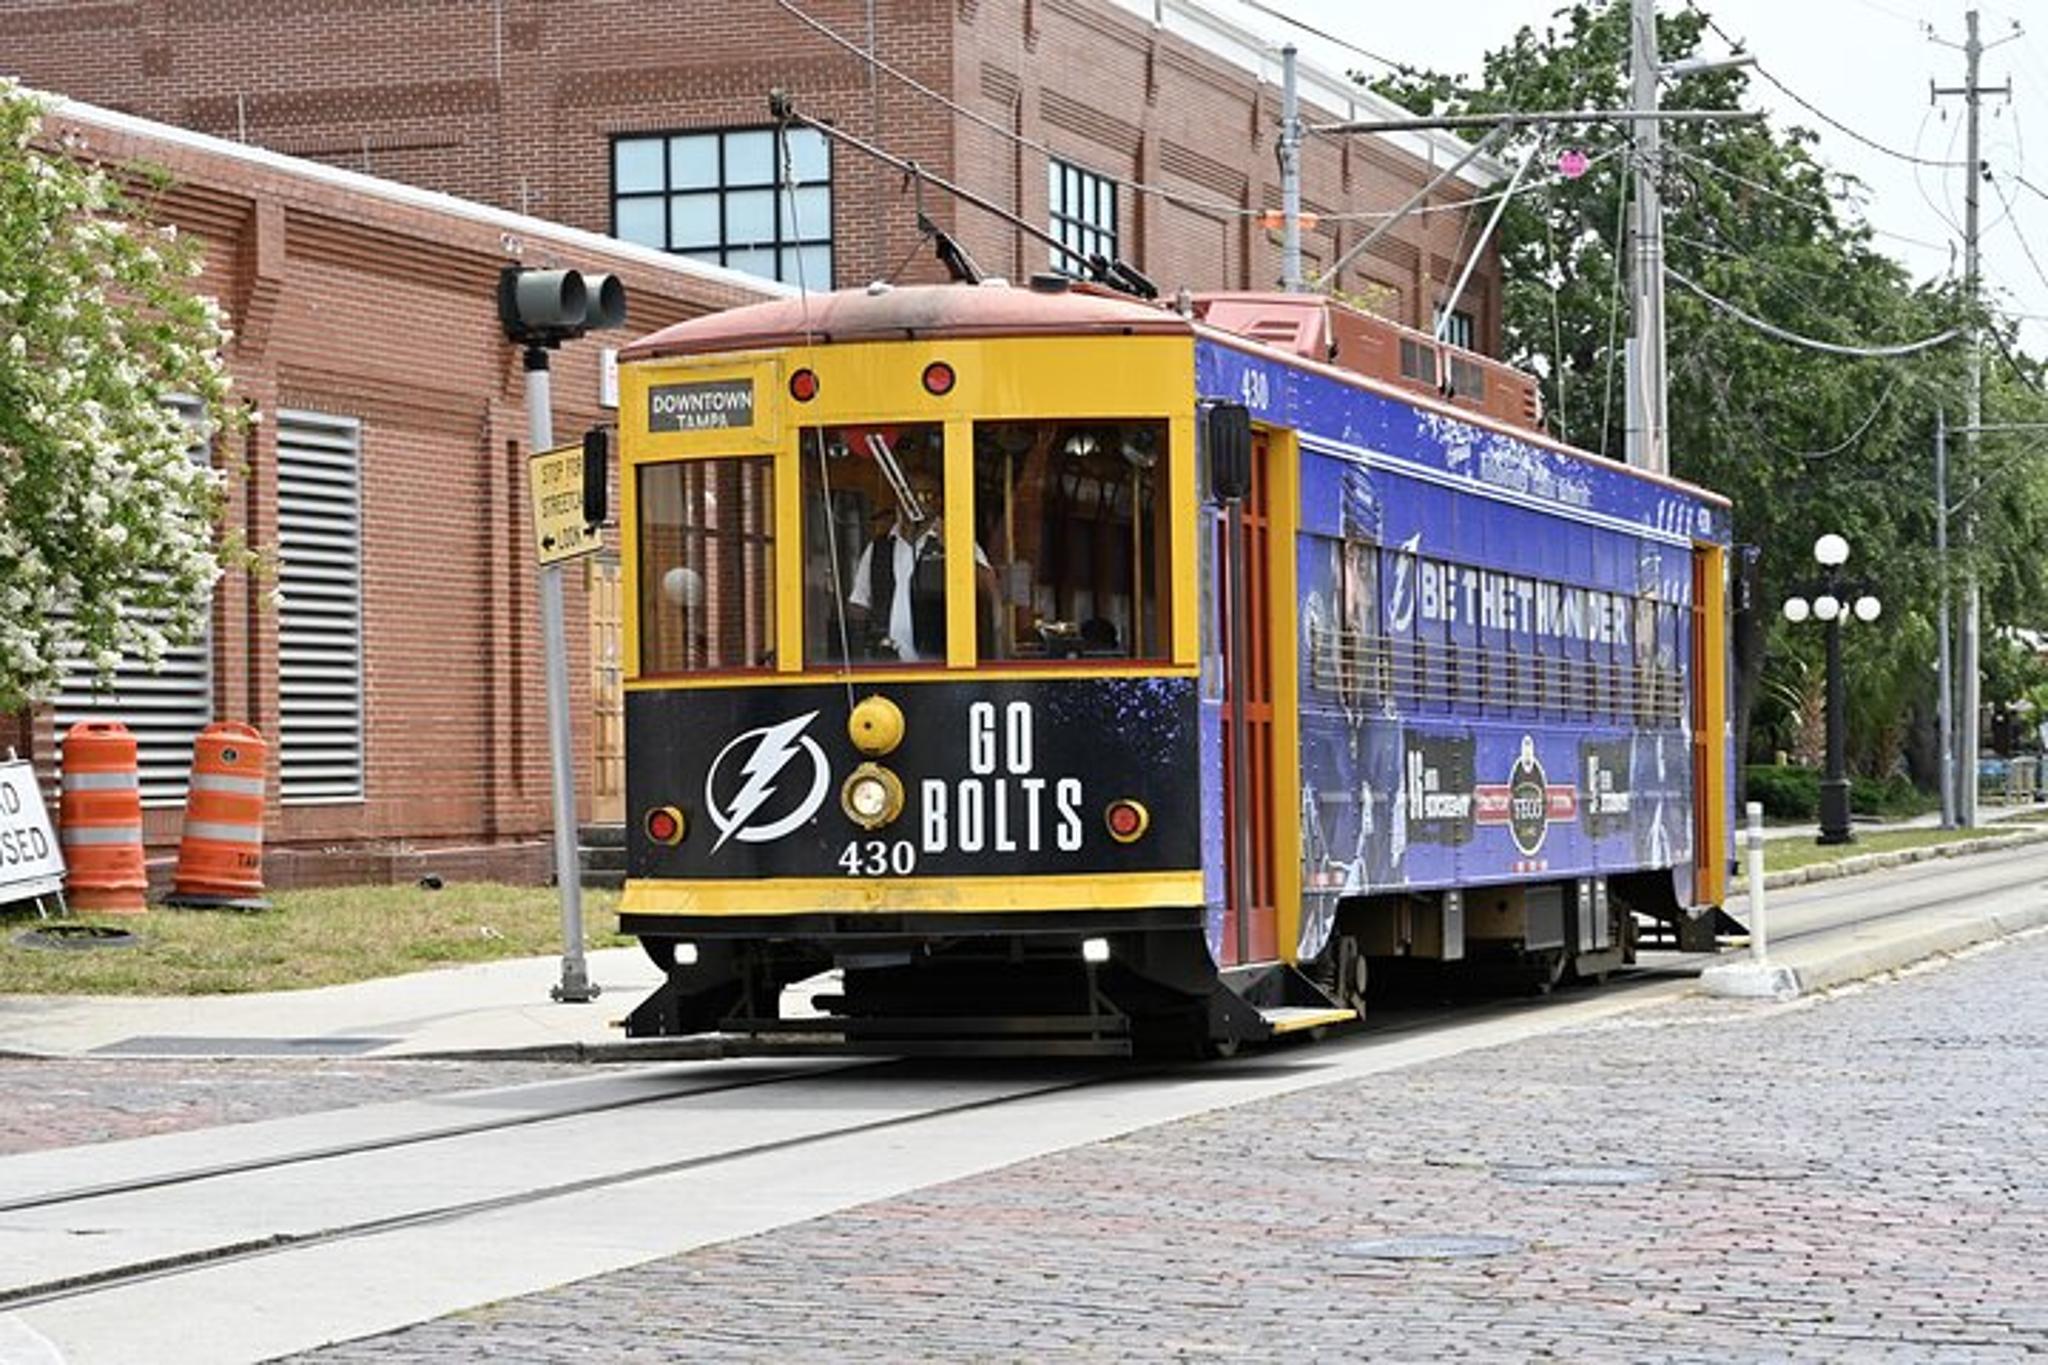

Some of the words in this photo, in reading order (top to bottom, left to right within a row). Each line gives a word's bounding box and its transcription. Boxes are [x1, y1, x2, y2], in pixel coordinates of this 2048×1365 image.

[653, 391, 752, 413] DOWNTOWN
[1241, 368, 1269, 411] 430
[676, 411, 728, 431] TAMPA
[969, 701, 1033, 775] GO
[921, 778, 1083, 853] BOLTS
[838, 841, 916, 875] 430
